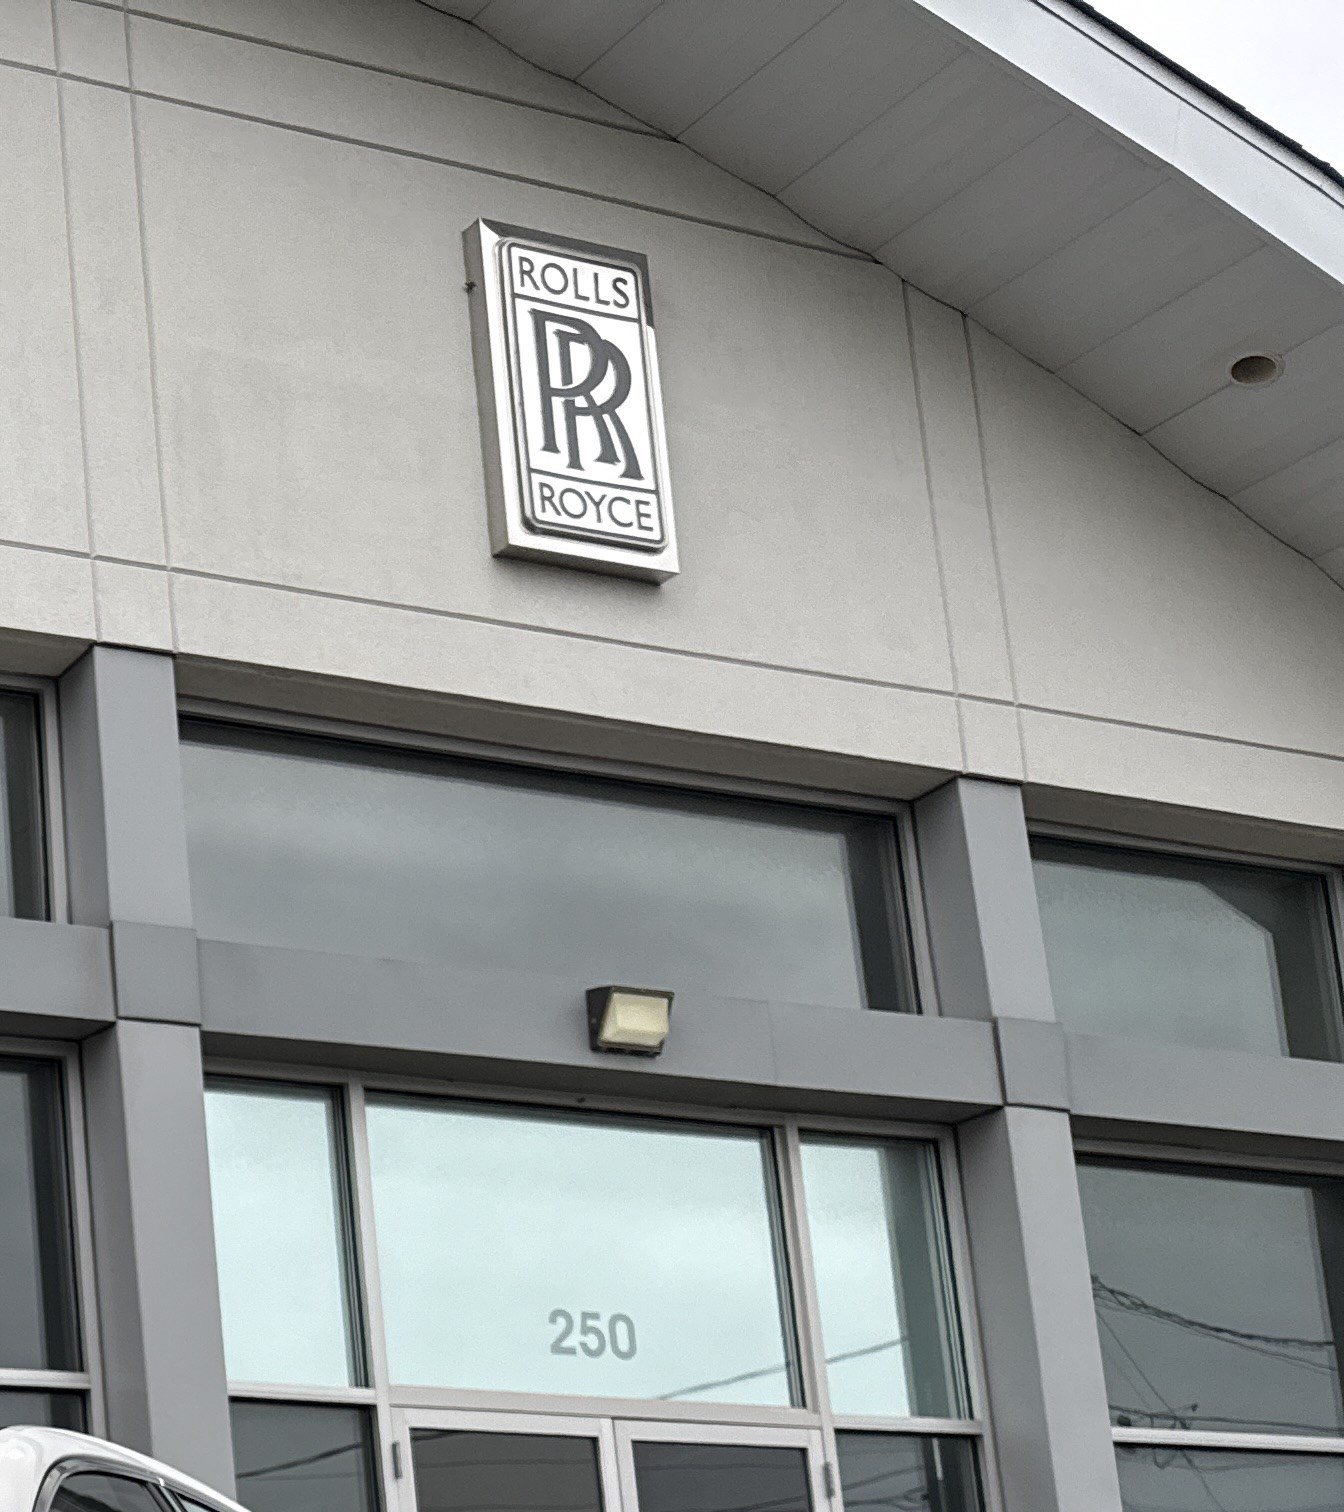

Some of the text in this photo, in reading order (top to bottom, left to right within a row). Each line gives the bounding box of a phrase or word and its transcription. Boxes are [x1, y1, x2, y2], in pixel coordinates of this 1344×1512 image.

[518, 256, 630, 309] ROLLS
[538, 481, 654, 532] ROYCE
[548, 1309, 637, 1361] 250
